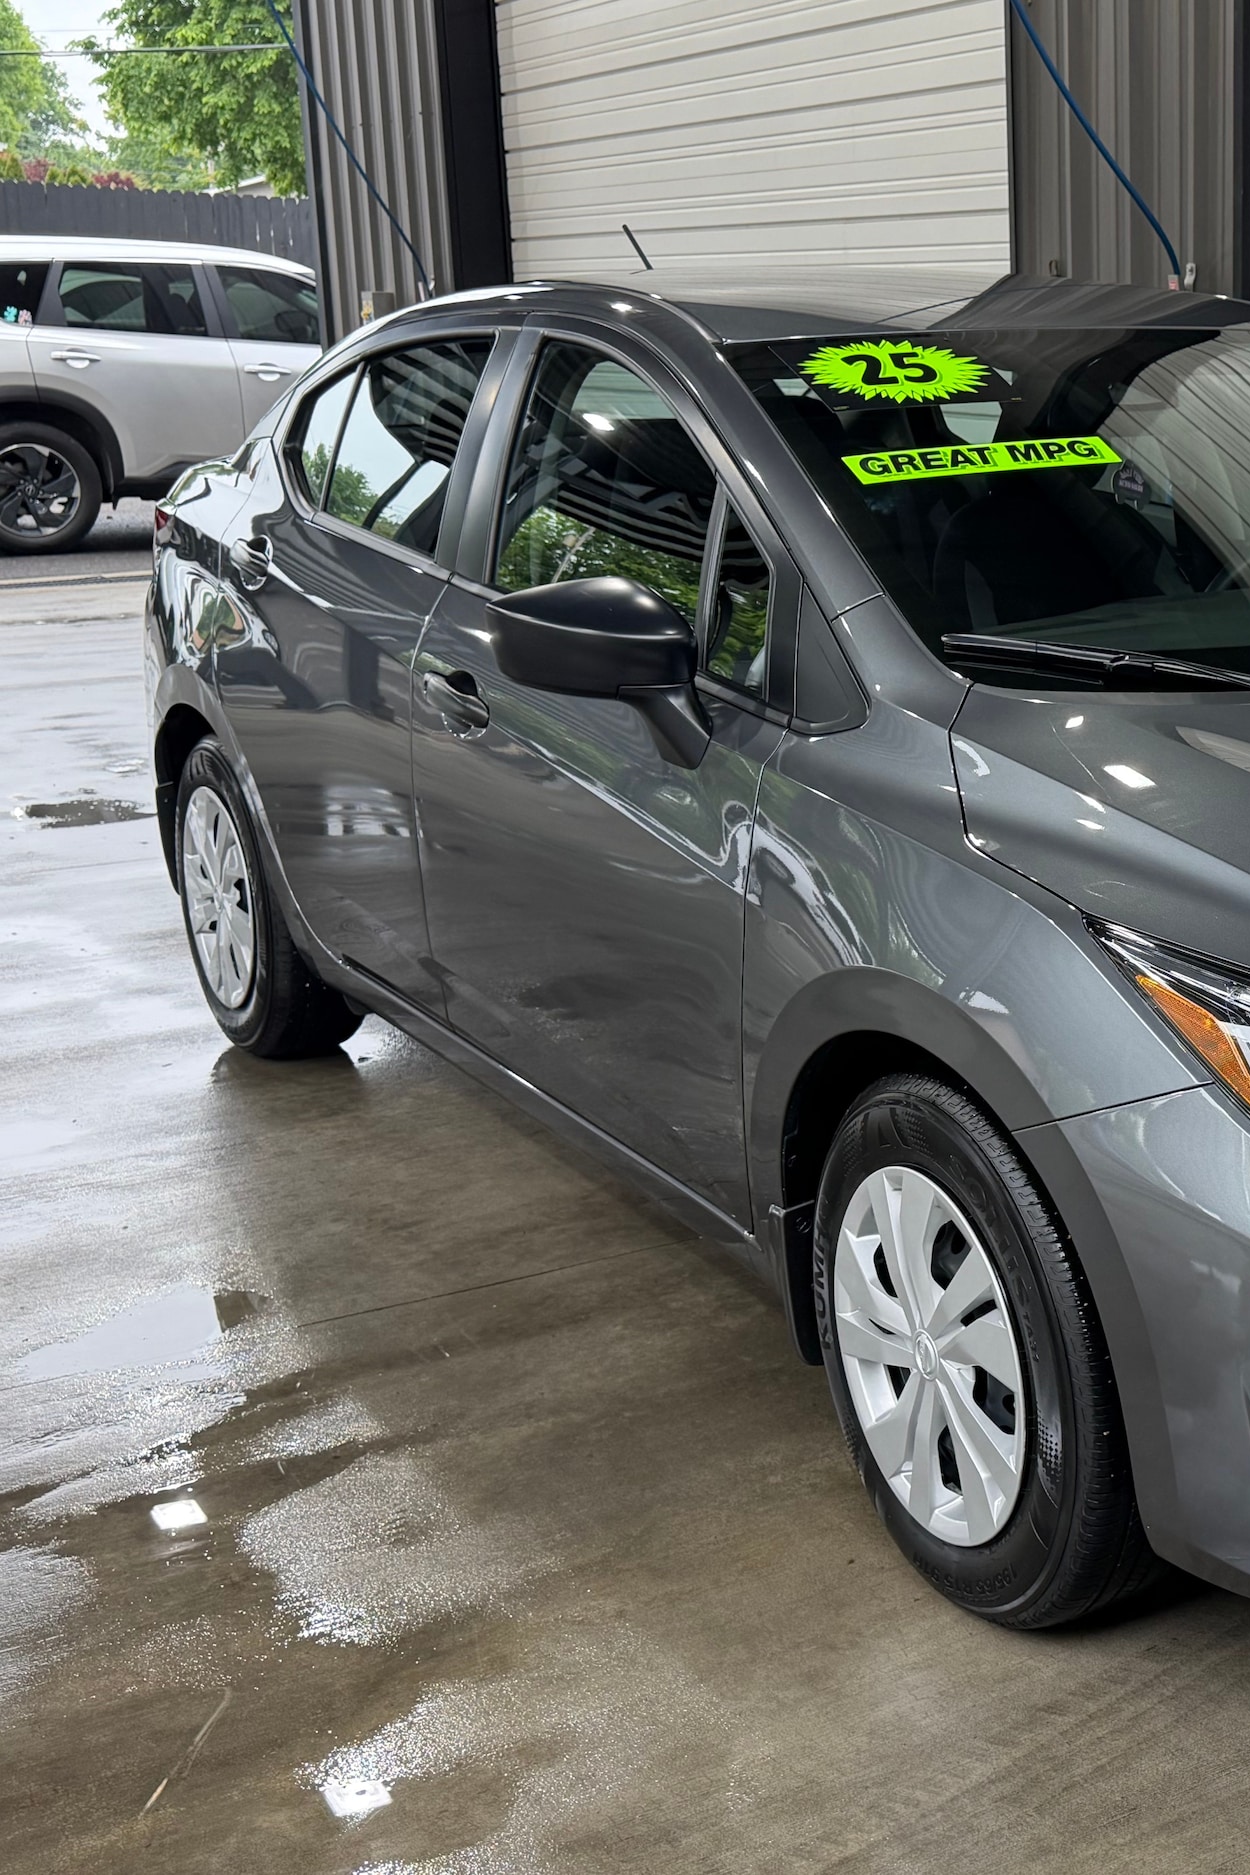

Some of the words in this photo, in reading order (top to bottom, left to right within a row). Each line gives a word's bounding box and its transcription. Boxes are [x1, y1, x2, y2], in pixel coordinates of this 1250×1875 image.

[841, 351, 939, 385] 25
[859, 445, 999, 477] GREAT
[1007, 439, 1098, 465] MPG
